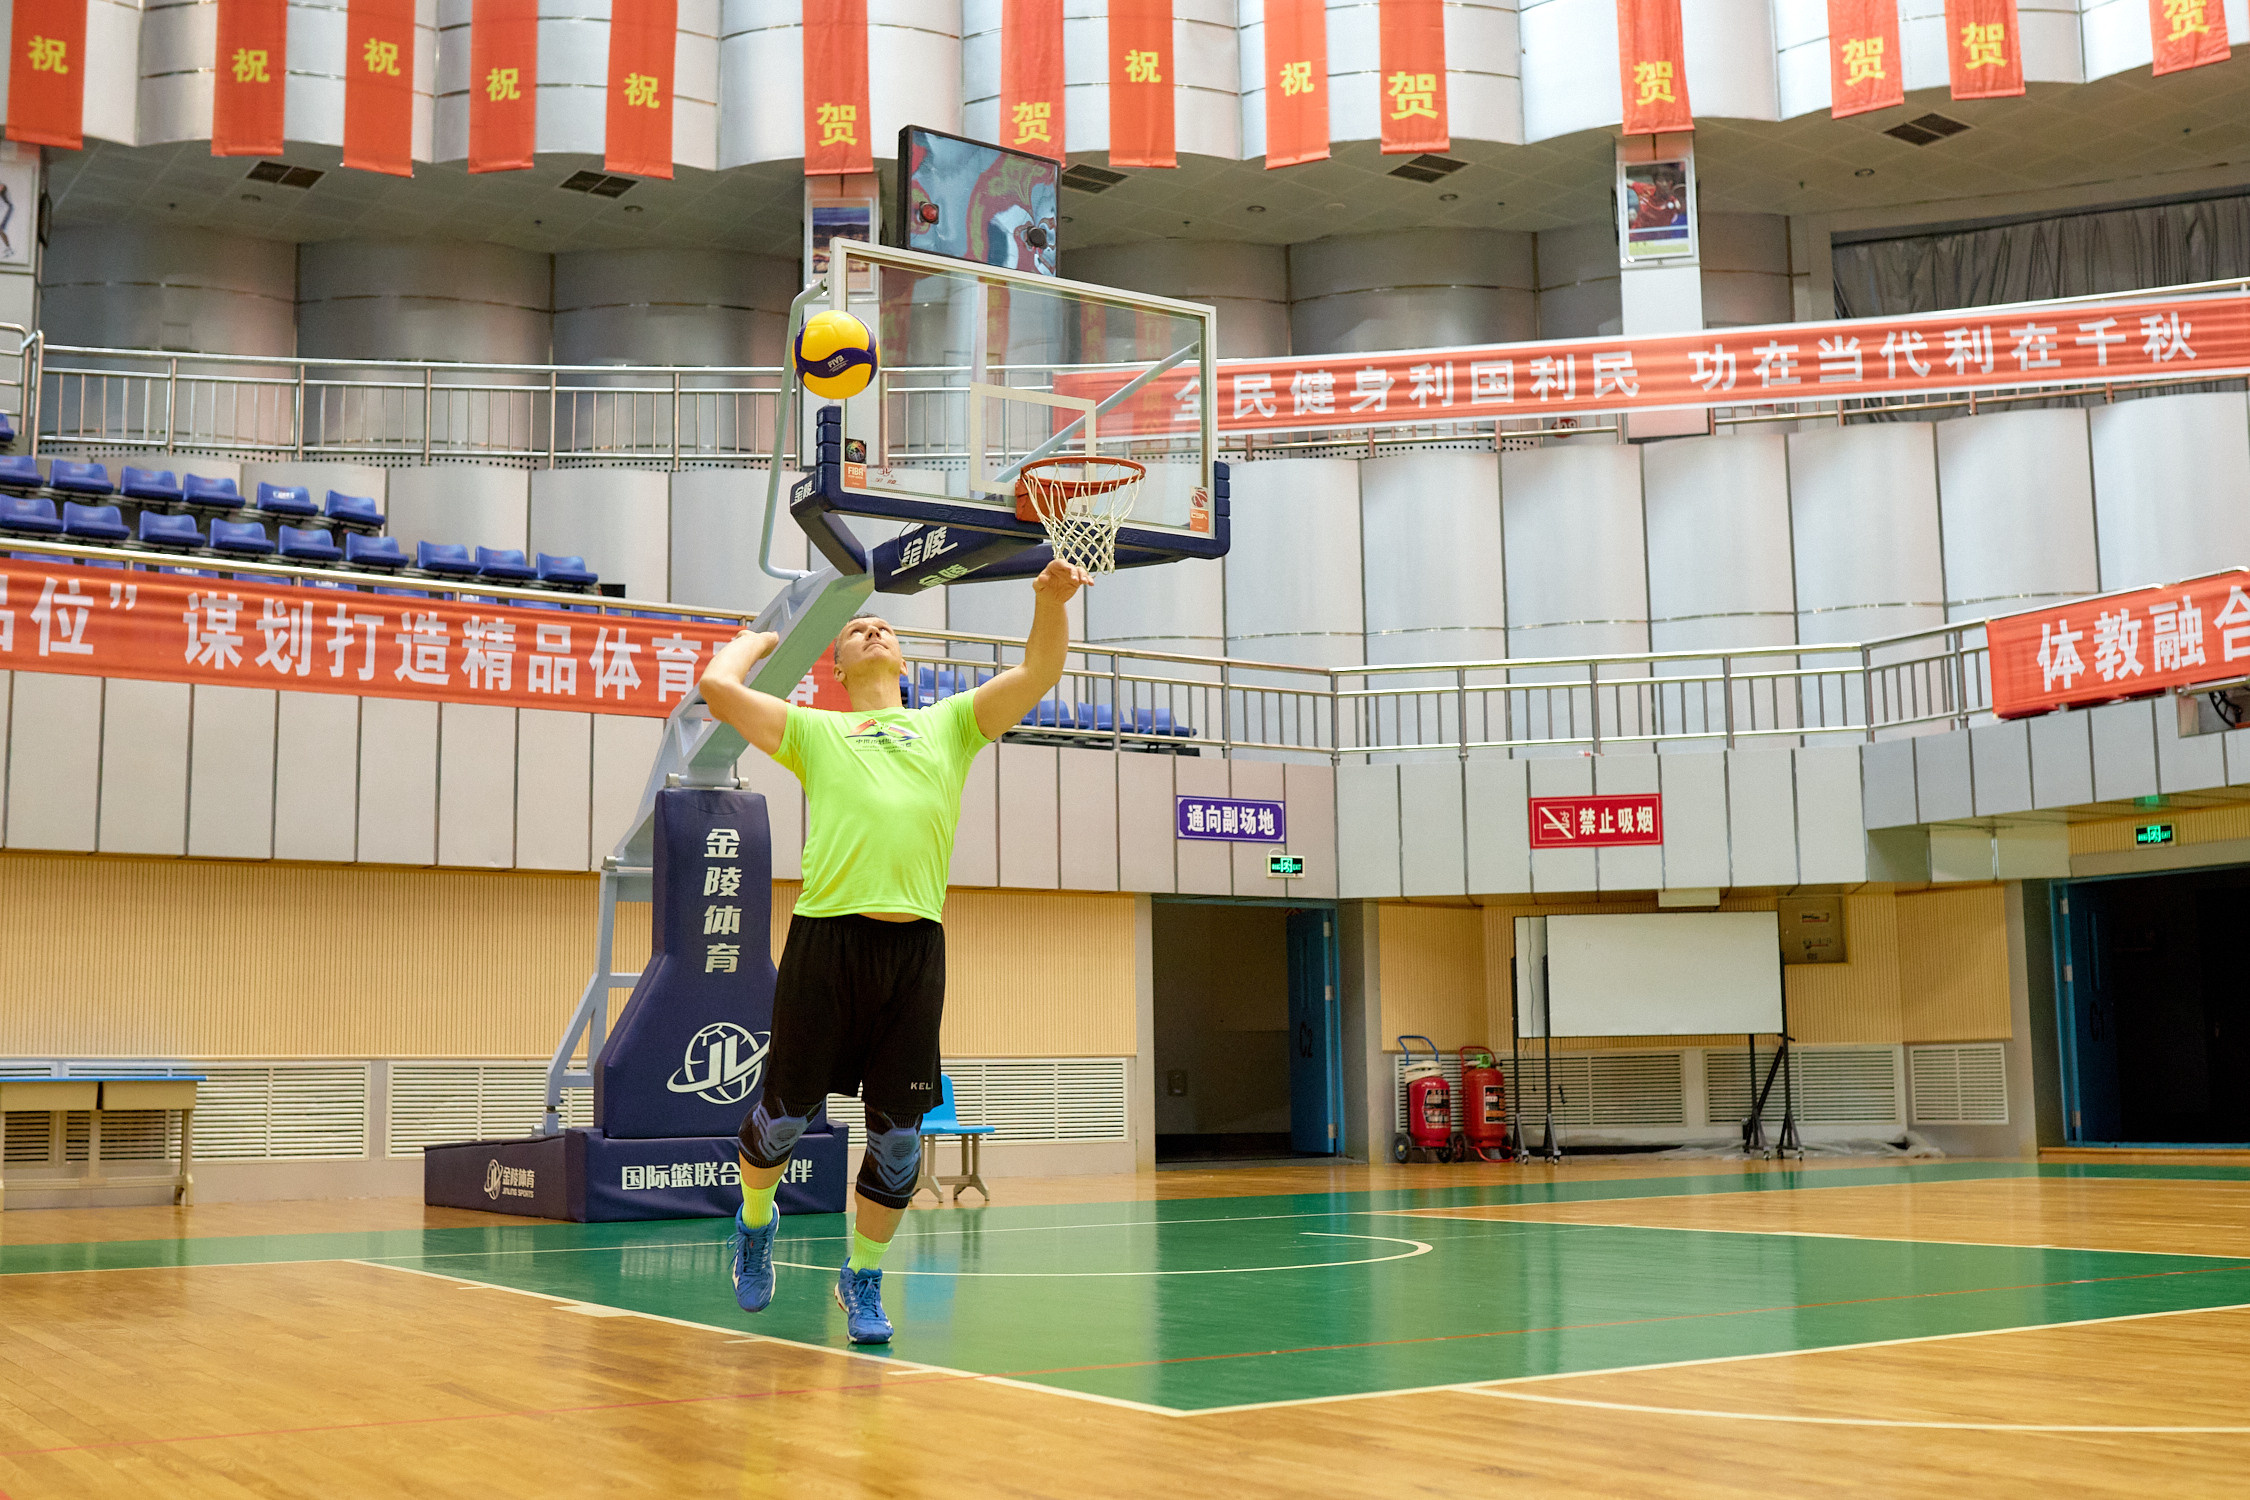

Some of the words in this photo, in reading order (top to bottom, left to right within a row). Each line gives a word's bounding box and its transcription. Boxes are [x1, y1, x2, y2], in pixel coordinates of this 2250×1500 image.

[2163, 0, 2210, 42] 贺
[28, 35, 68, 74] 祝
[232, 48, 270, 83] 祝
[363, 37, 401, 77] 祝
[1124, 48, 1162, 84] 祝
[1842, 36, 1886, 87] 贺
[1960, 22, 2007, 69] 贺
[486, 67, 521, 102] 祝
[623, 72, 660, 109] 祝
[1279, 60, 1314, 97] 祝
[1387, 71, 1439, 120] 贺
[1633, 60, 1677, 106] 贺
[816, 102, 859, 147] 贺
[1012, 101, 1052, 145] 贺
[1174, 350, 1641, 421] 全民健身利国利民
[1689, 311, 2198, 393] 功在当代利在千秋
[847, 466, 864, 477] FIBA
[892, 526, 957, 575] 金陵
[183, 591, 819, 706] 谋划打造精品体育
[2037, 586, 2250, 692] 体教融合
[1187, 804, 1275, 836] 通向副场地
[1579, 806, 1654, 836] 禁止吸烟
[703, 828, 743, 973] 金陵体育
[621, 1159, 813, 1190] 国际篮联合伴
